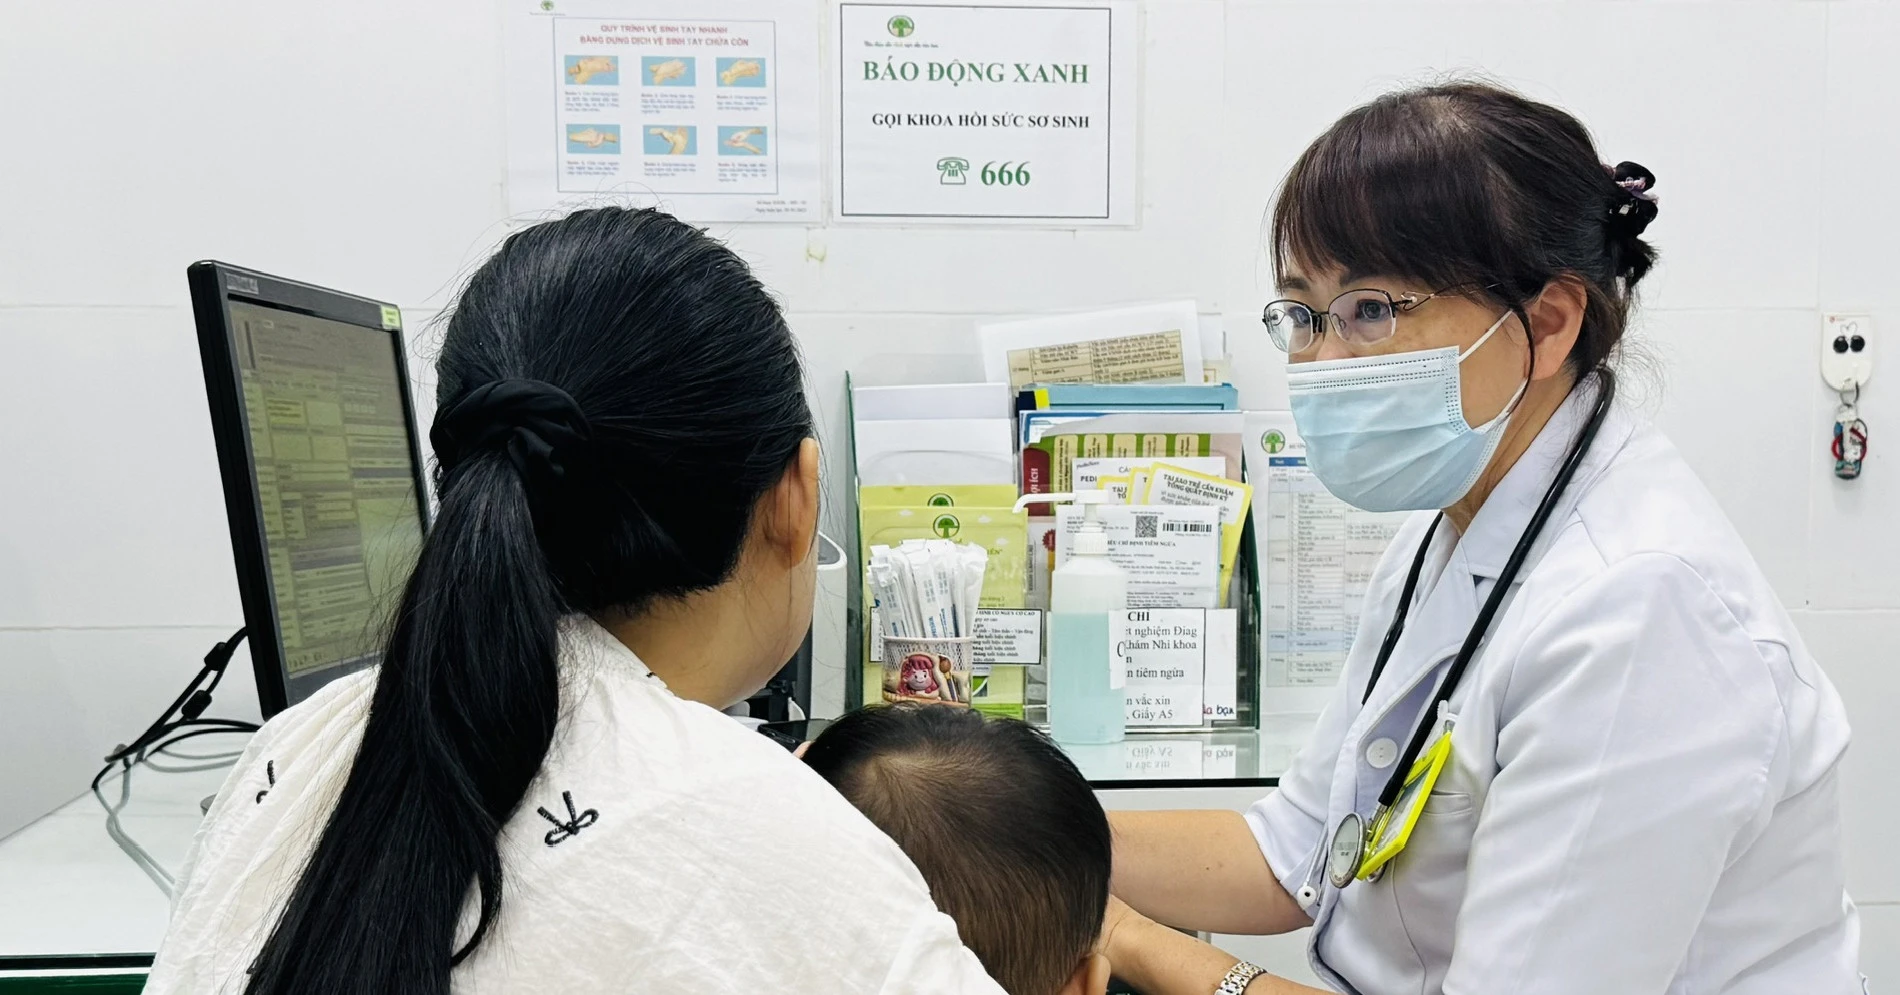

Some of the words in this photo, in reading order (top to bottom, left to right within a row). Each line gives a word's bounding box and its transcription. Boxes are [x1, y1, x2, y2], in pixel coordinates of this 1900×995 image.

[681, 25, 697, 34] TAY
[698, 26, 728, 34] NHANH
[862, 55, 920, 82] BÁO
[927, 58, 1005, 87] ĐỘNG
[1012, 63, 1090, 84] XANH
[872, 113, 902, 129] GỌI
[907, 114, 953, 127] KHOA
[992, 111, 1024, 128] SỨC
[1027, 114, 1050, 128] SƠ
[1052, 115, 1090, 128] SINH
[980, 160, 1032, 187] 666
[1134, 625, 1171, 638] nghiệm
[1126, 639, 1150, 650] hám
[1152, 639, 1170, 650] Nhi
[1173, 639, 1197, 650] khoa
[1136, 667, 1158, 678] tiêm
[1135, 693, 1153, 705] vắc
[1154, 694, 1171, 705] xin
[1132, 707, 1155, 721] Giấy
[1158, 709, 1173, 719] A5
